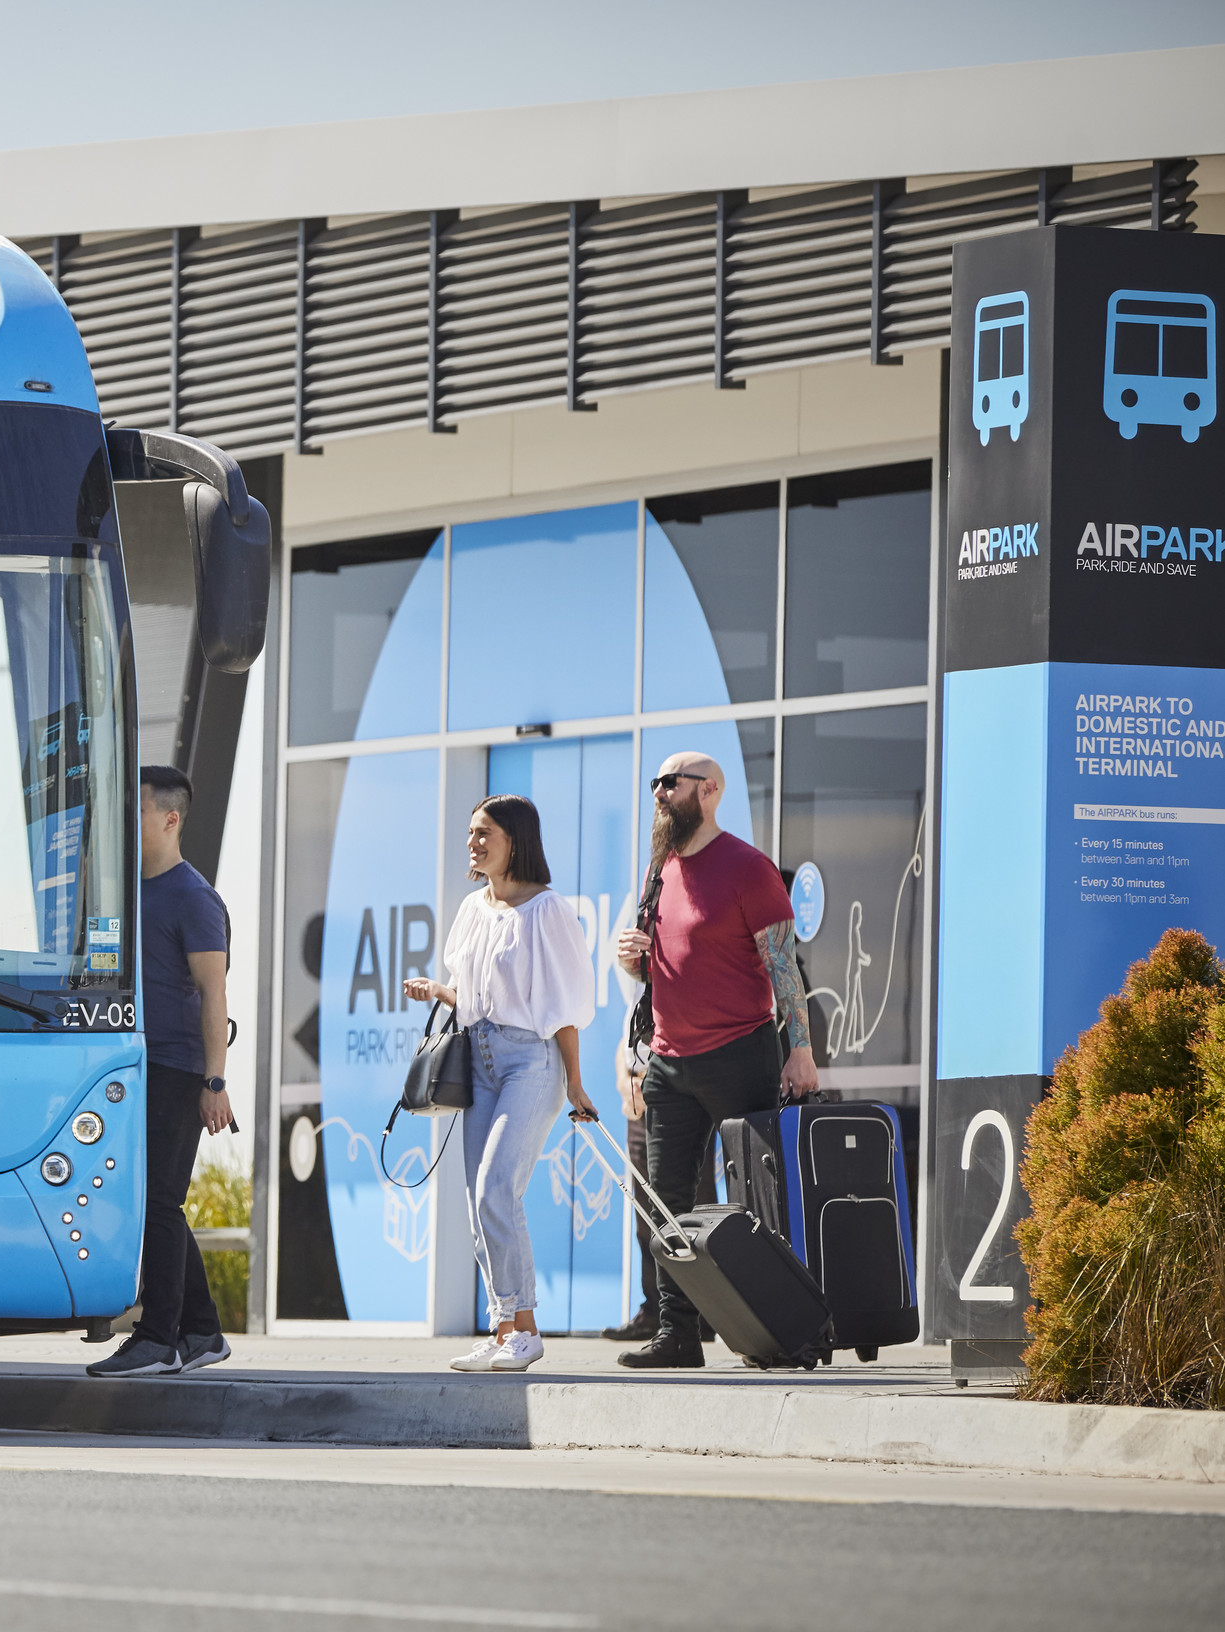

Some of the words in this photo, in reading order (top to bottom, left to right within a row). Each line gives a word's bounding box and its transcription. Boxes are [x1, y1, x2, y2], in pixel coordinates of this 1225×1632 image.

[958, 522, 1039, 566] AIRPARK
[1139, 562, 1165, 575] AND
[1167, 563, 1197, 577] SAVE
[1075, 694, 1162, 714] AIRPARK
[1166, 697, 1194, 715] TO
[1076, 715, 1181, 736] DOMESTIC
[1186, 719, 1225, 737] AND
[1075, 757, 1178, 778] TERMINAL
[1079, 807, 1096, 817] The
[1097, 808, 1138, 818] AIRPARK
[1139, 810, 1155, 819] bus
[1156, 812, 1178, 820] runs:
[1081, 837, 1109, 850] Every
[1111, 838, 1123, 849] 15
[1125, 840, 1164, 850] minutes
[1081, 853, 1122, 864] between
[1124, 854, 1145, 865] 3am
[1147, 856, 1165, 866] and
[1166, 856, 1190, 868] 11pm
[1080, 876, 1109, 888] Every
[1111, 877, 1124, 888] 30
[1126, 878, 1165, 889] minutes
[1080, 891, 1122, 902] between
[1123, 893, 1147, 905] 11pm
[1148, 894, 1167, 904] and
[1168, 894, 1190, 905] 3am
[63, 1002, 136, 1027] EV-03
[959, 1109, 1014, 1300] 2
